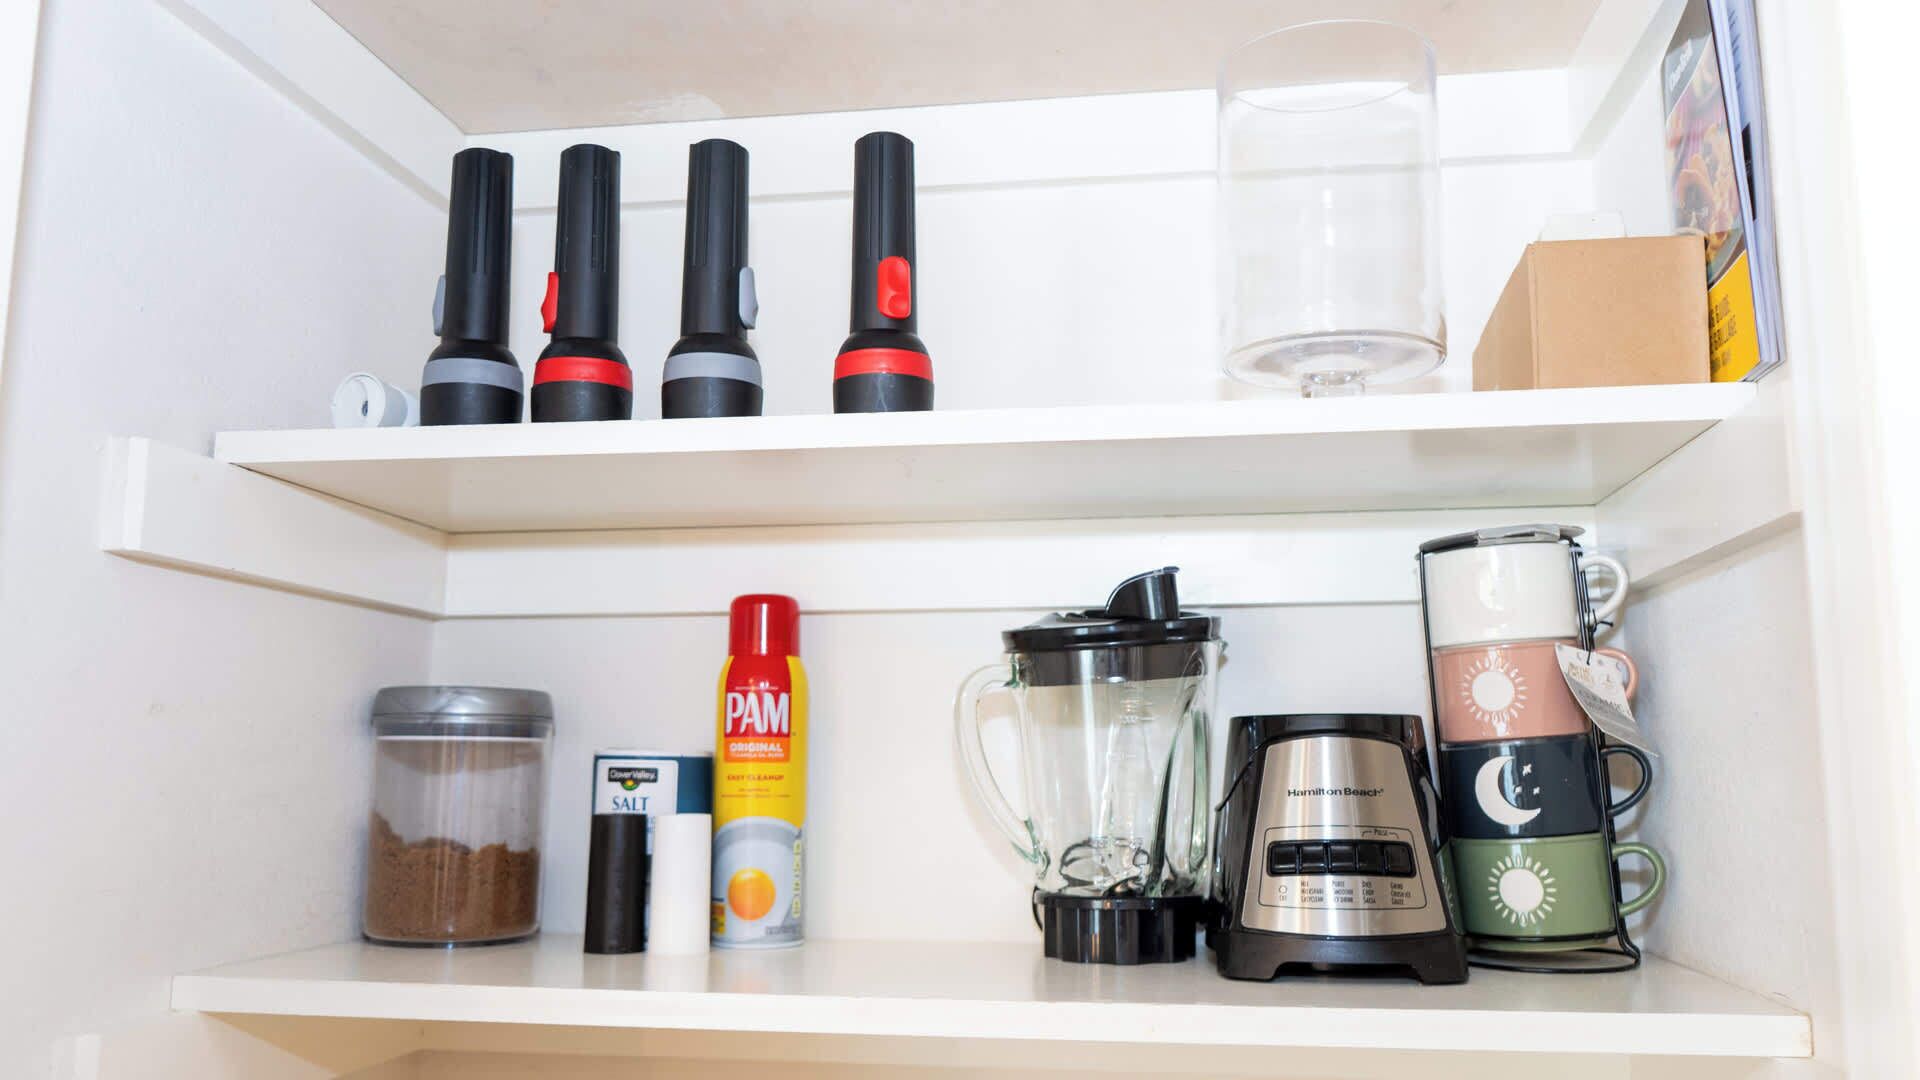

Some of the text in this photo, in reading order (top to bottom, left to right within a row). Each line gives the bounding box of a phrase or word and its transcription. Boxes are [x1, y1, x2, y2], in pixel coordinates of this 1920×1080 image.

[726, 692, 789, 734] PAM
[729, 742, 784, 752] ORIGINAL
[1287, 787, 1343, 798] Hamilton
[612, 795, 650, 811] SALT
